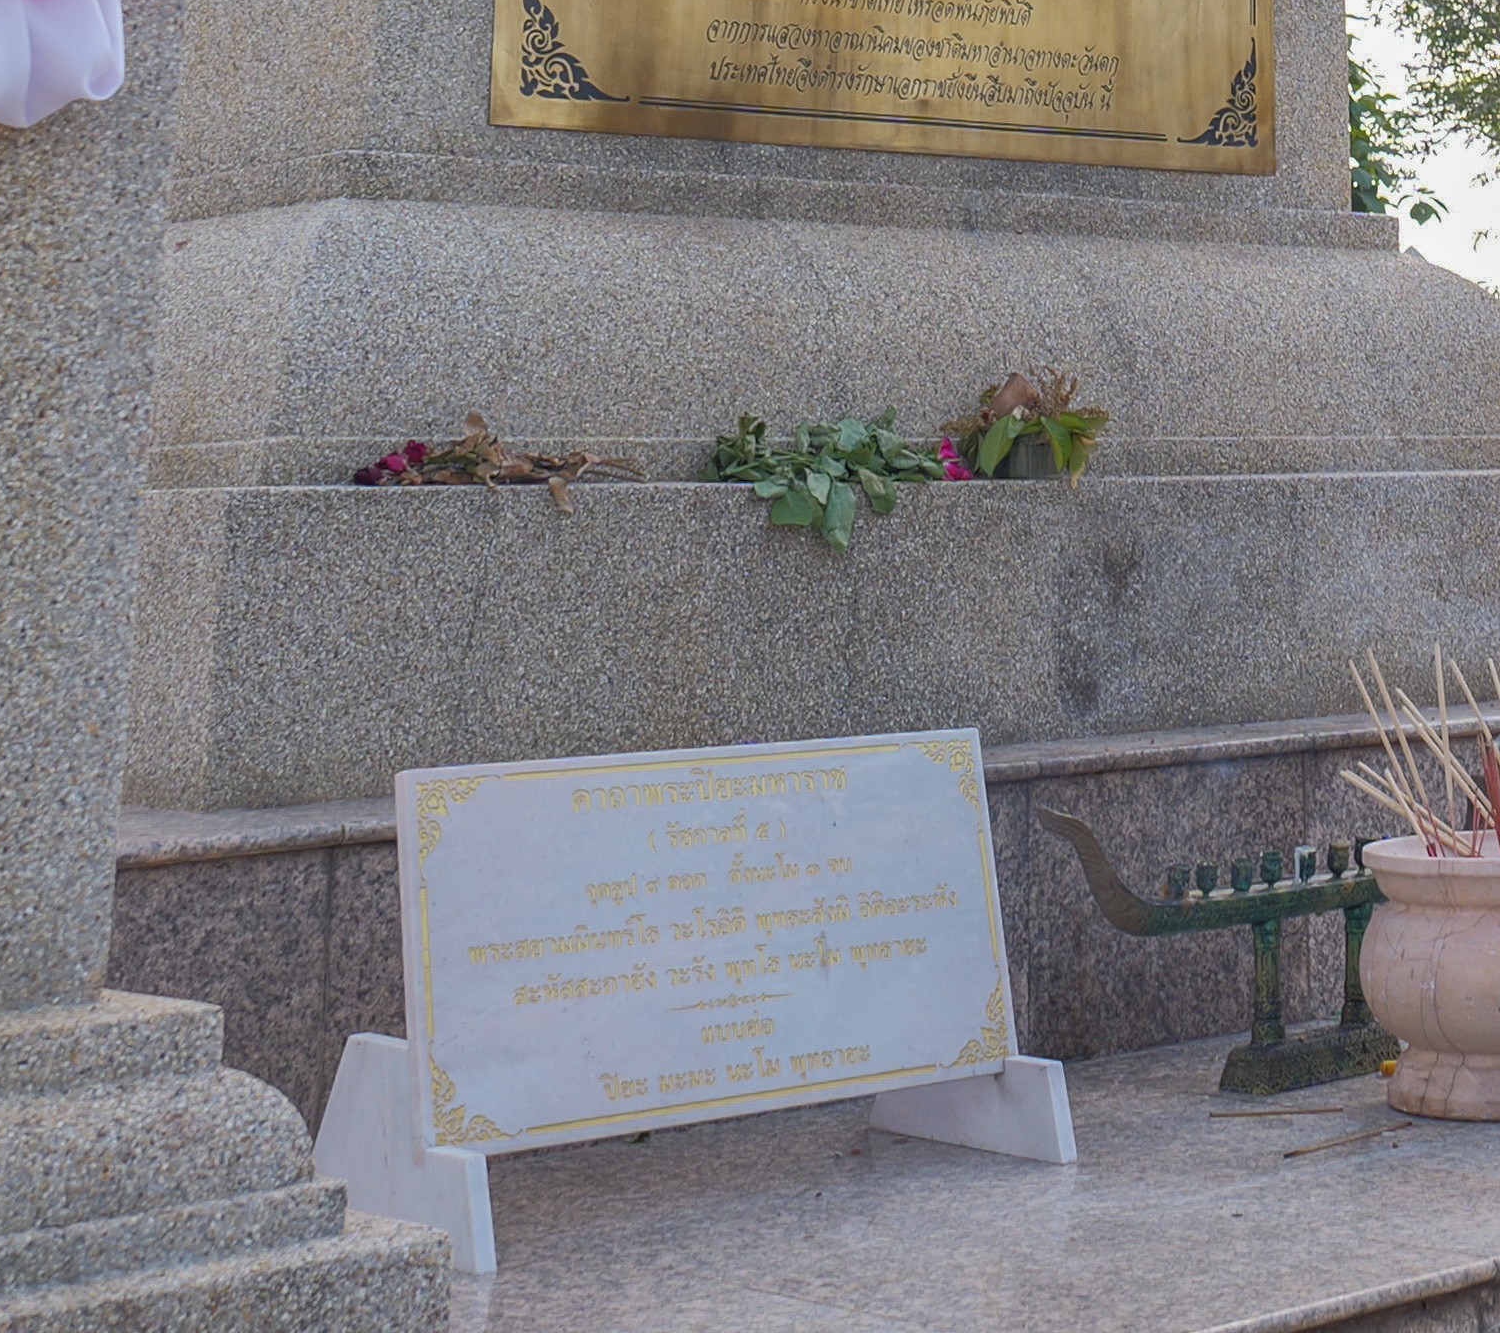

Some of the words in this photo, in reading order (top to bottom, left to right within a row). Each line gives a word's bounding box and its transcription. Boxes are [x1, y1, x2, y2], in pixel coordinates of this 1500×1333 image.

[1099, 77, 1114, 112] นี้
[754, 820, 771, 841] ๕
[582, 871, 639, 910] จุดธูป
[643, 876, 661, 894] ๙
[666, 870, 709, 893] ดอก
[727, 851, 801, 886] ตั้งนะโม
[804, 861, 822, 878] ๓
[824, 854, 853, 875] จบ
[666, 955, 717, 987] วะรัง
[723, 941, 781, 987] พุทโธ
[786, 934, 843, 972] นะโม
[848, 936, 929, 971] พุทธายะ
[698, 1007, 777, 1046] แบบย่อ
[597, 1070, 649, 1102] ปิยะ
[656, 1067, 717, 1094] มะมะ
[723, 1043, 782, 1083] นะโม
[788, 1043, 871, 1077] พุทธายะ
